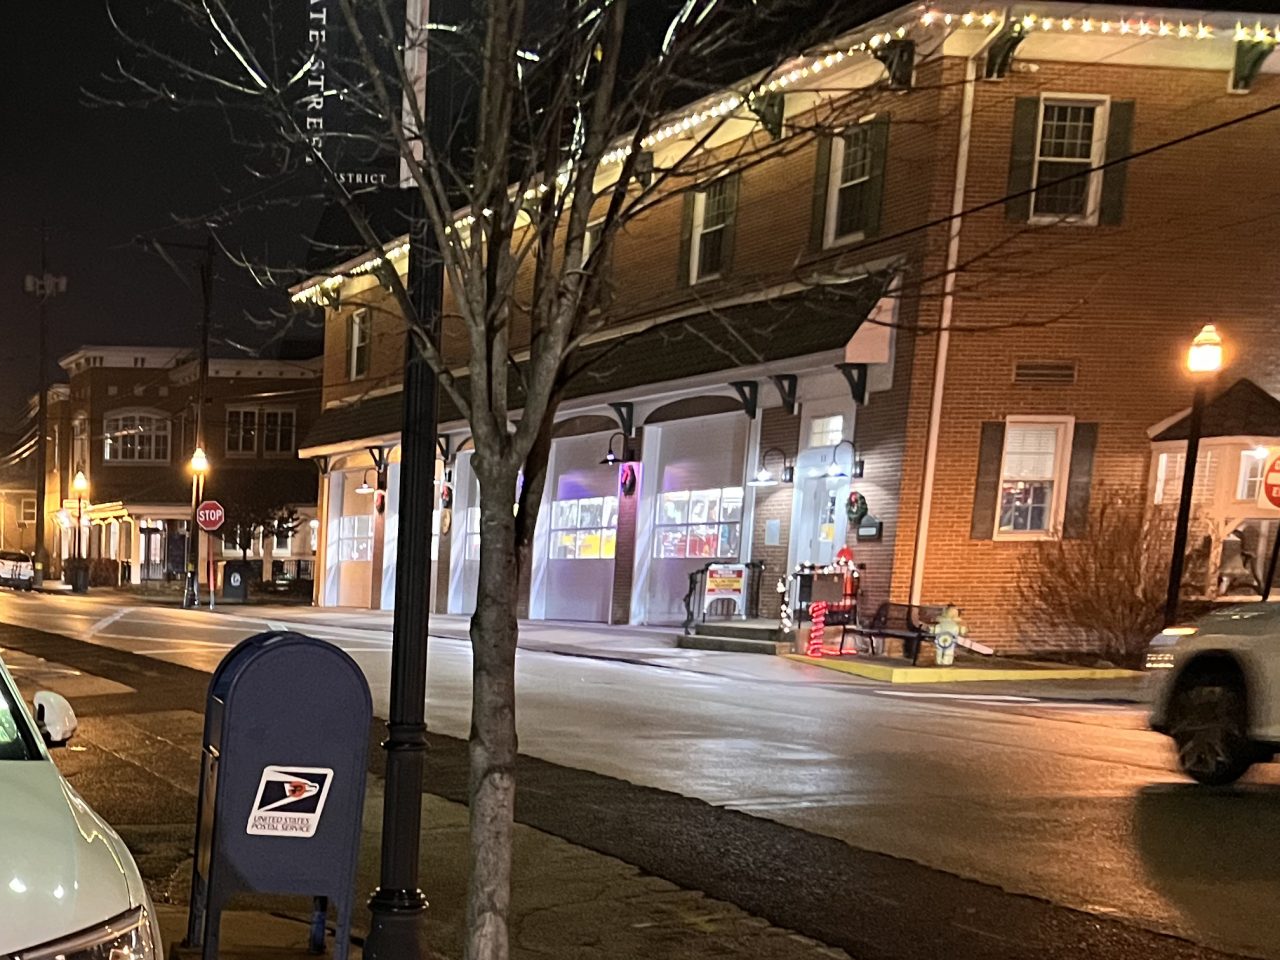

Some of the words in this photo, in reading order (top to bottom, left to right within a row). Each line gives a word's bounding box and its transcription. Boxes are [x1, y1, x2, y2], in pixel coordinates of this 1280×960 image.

[308, 0, 327, 43] TE
[306, 57, 326, 164] STREE
[328, 172, 387, 184] STRICT
[199, 509, 222, 521] STOP
[253, 815, 283, 824] UNITED
[284, 817, 310, 825] STATES
[251, 823, 279, 831] POSTAL
[281, 824, 311, 832] SERVICE
